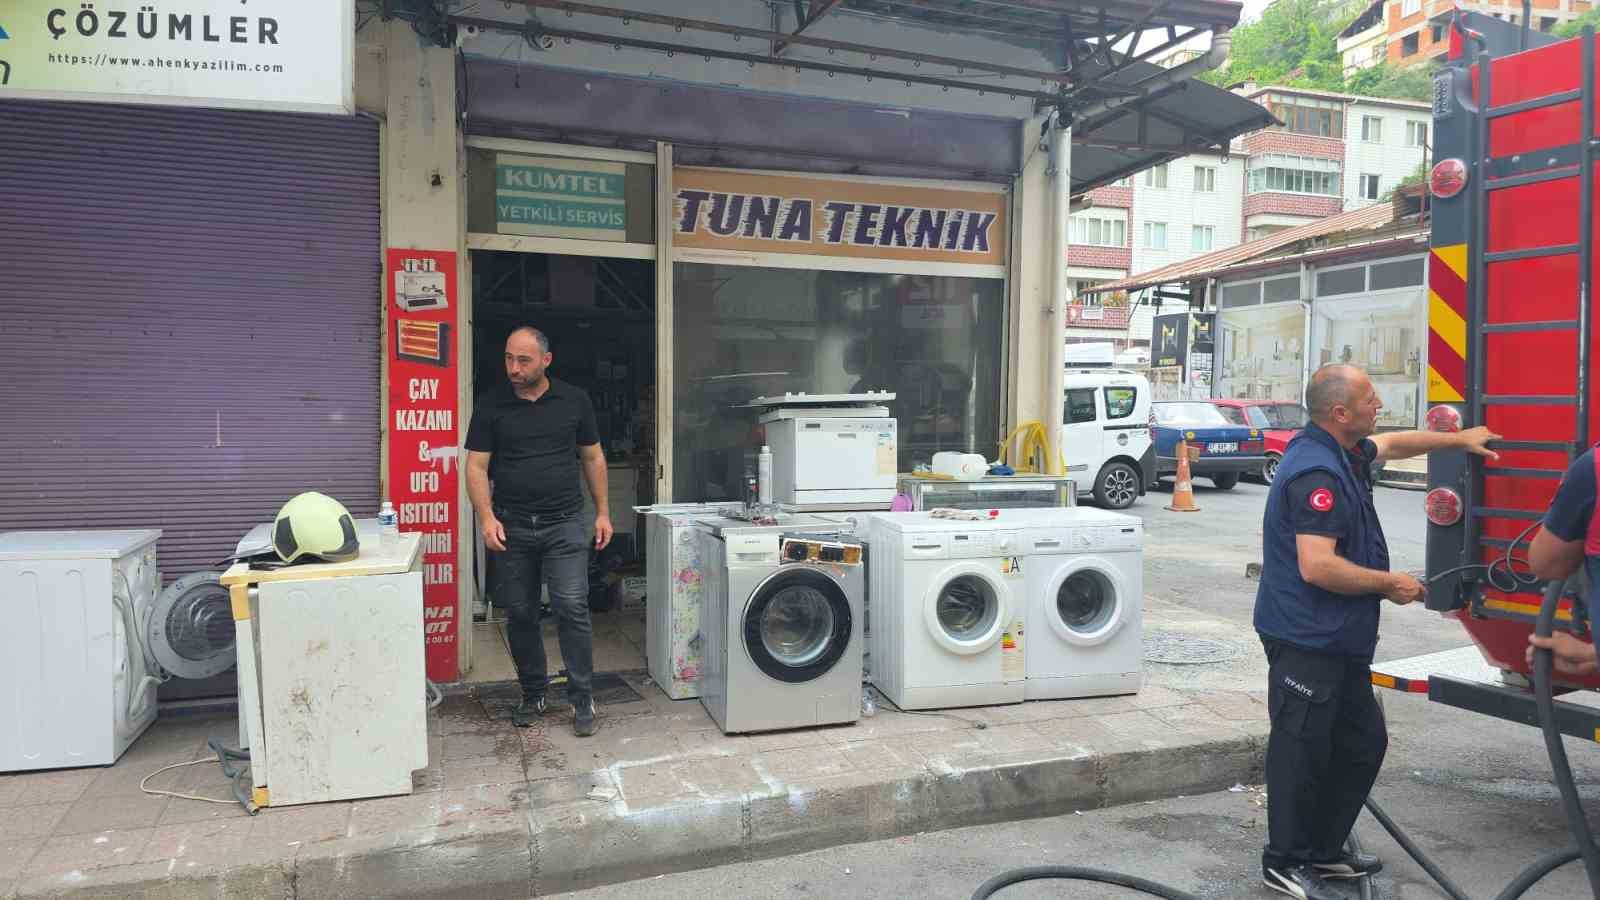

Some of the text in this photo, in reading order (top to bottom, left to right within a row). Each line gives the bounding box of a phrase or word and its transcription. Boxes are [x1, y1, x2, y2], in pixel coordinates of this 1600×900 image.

[47, 3, 279, 45] ÇÖZÜMLER
[48, 53, 284, 73] https://www.ahenkyazilim.com
[505, 168, 613, 194] KUMTEL
[499, 205, 624, 226] YETKİLİ SERVİS
[675, 187, 997, 254] TUNA TEKNİK
[409, 378, 439, 403] ÇAY
[396, 409, 452, 431] KAZANI
[418, 440, 431, 462] &
[410, 471, 439, 493] UFO
